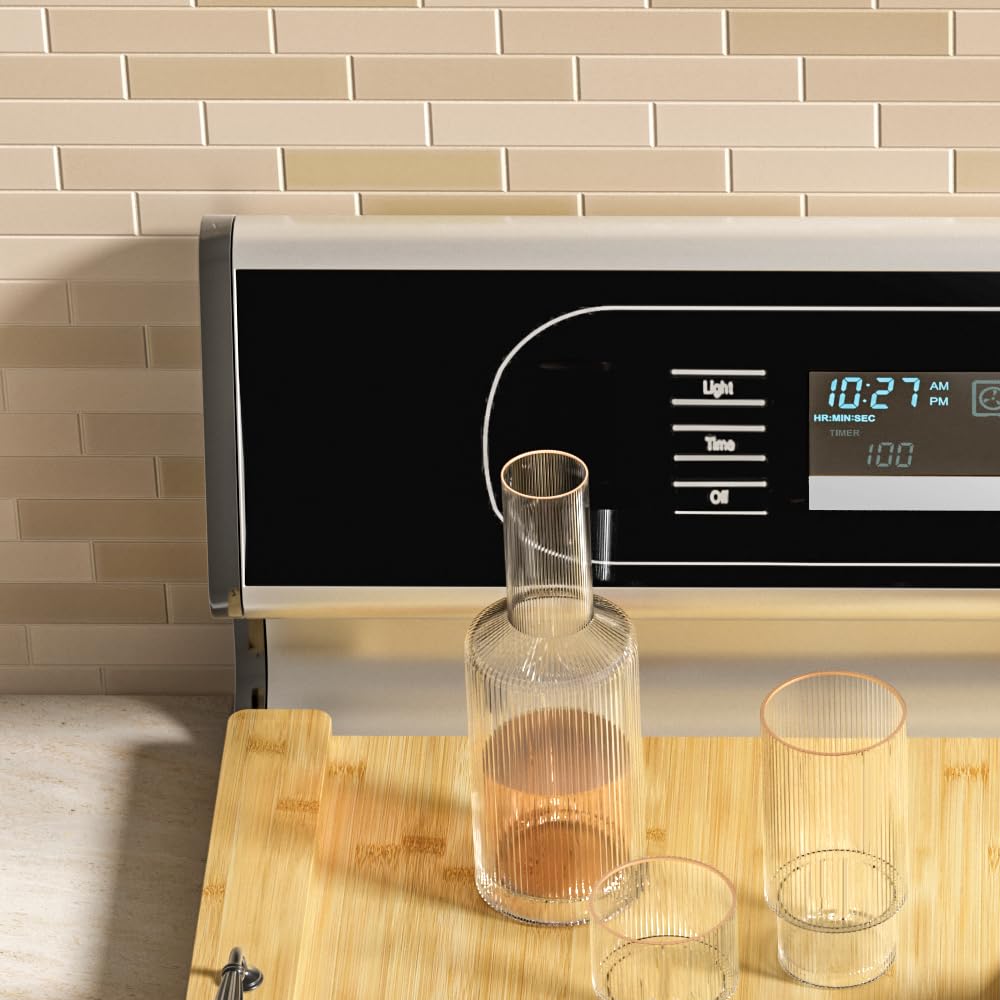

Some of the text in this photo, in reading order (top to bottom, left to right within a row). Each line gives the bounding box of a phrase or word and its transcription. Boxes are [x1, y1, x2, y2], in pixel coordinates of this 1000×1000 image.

[702, 380, 734, 399] Light
[828, 377, 921, 409] 10:27
[929, 381, 949, 391] AM
[929, 397, 949, 406] PM
[830, 429, 860, 437] TIMER
[704, 436, 736, 452] Time
[867, 442, 914, 467] 100
